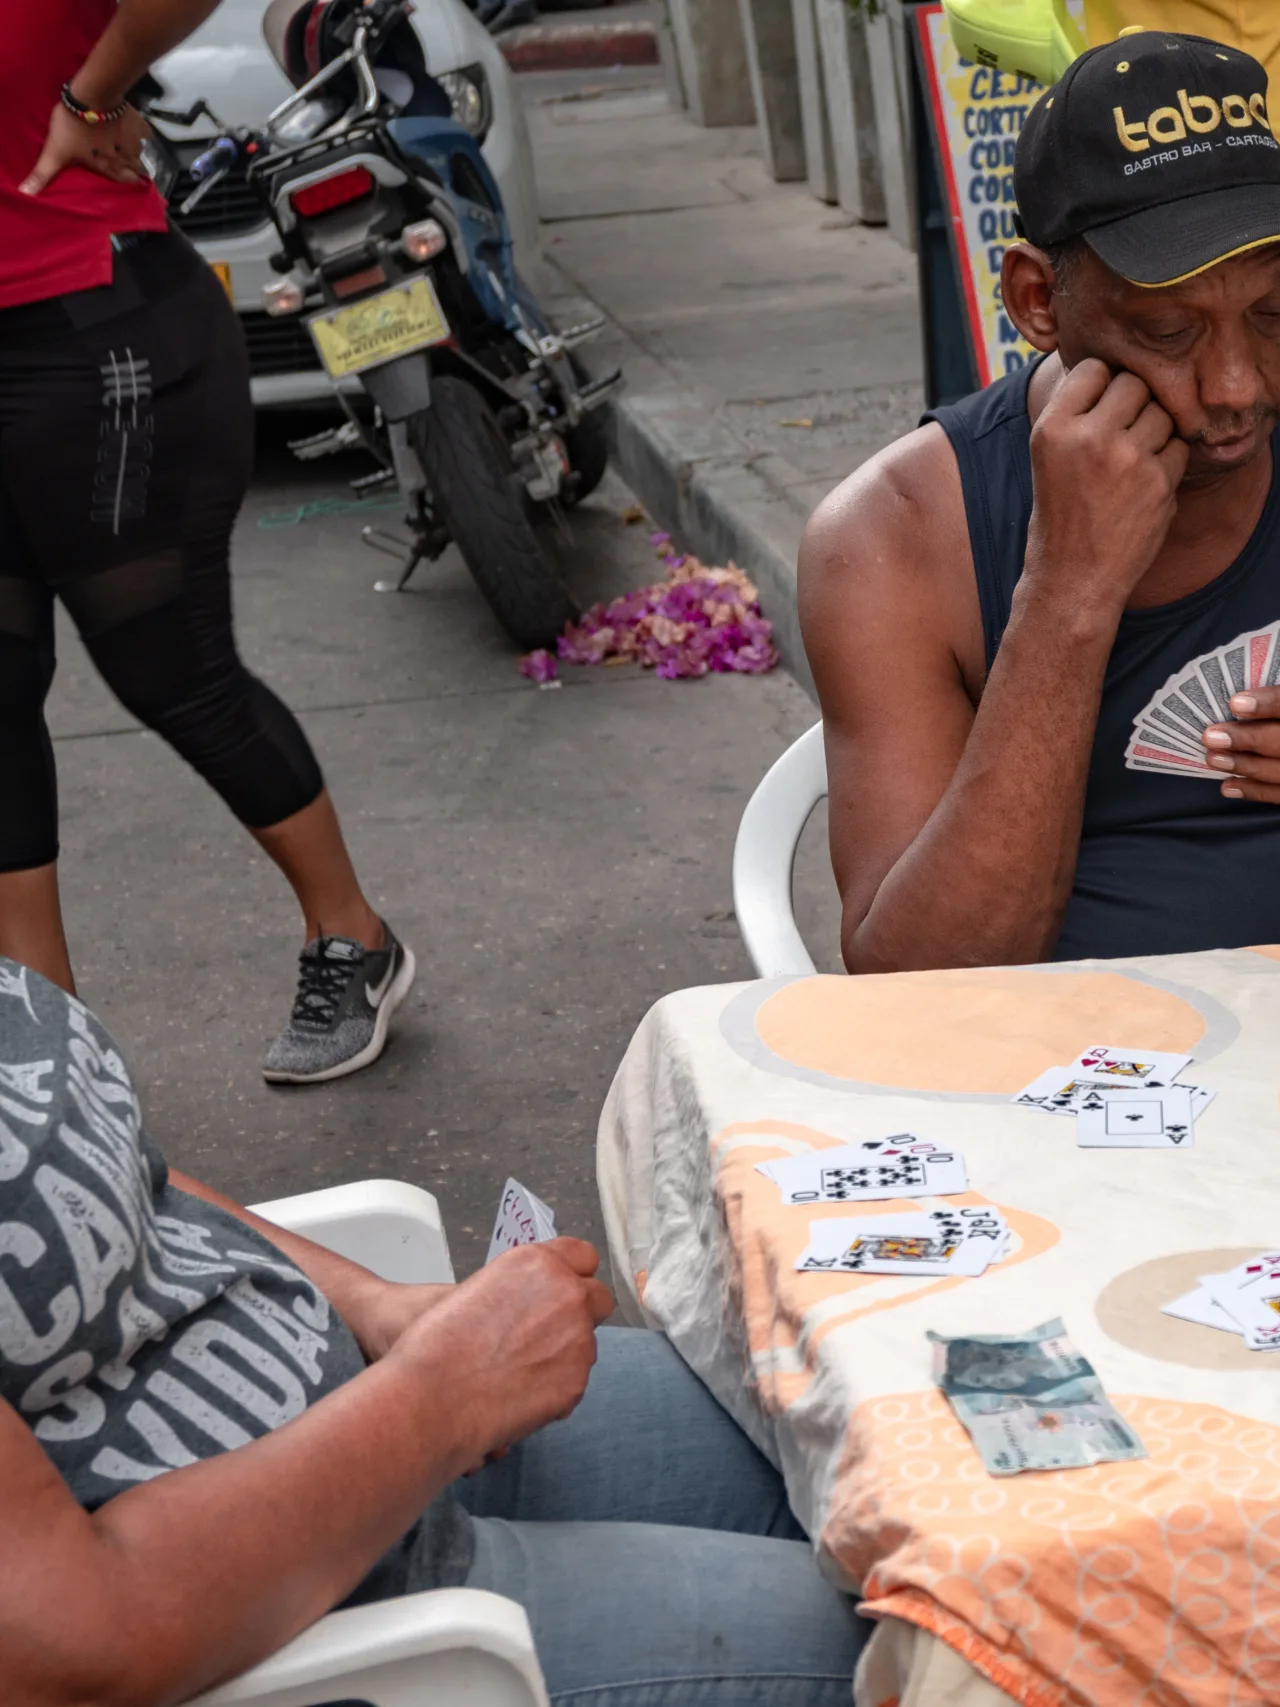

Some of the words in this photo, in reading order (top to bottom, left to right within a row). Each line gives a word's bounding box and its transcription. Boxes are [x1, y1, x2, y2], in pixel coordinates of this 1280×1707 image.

[1124, 149, 1179, 175] GASTRO
[1182, 141, 1213, 157] BAR
[1083, 1091, 1105, 1101] A
